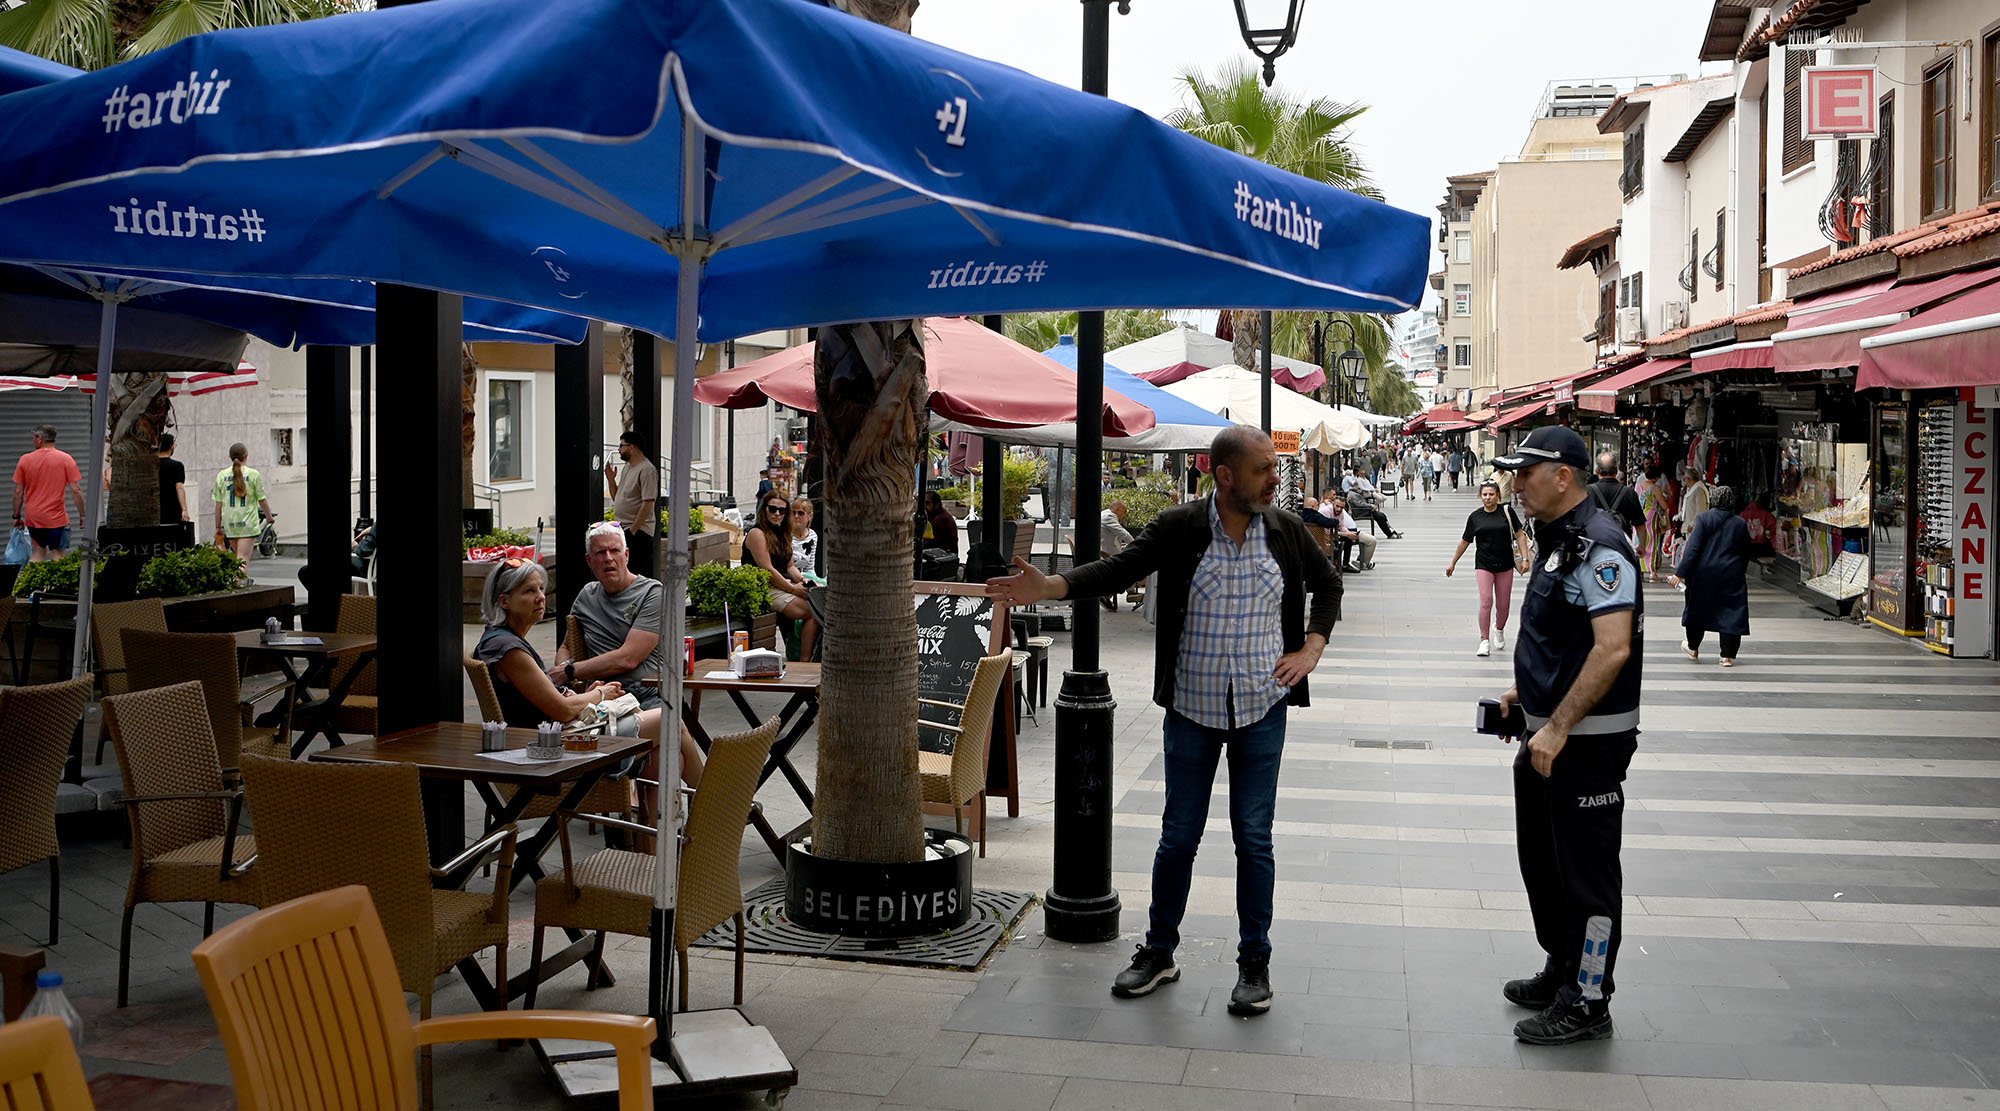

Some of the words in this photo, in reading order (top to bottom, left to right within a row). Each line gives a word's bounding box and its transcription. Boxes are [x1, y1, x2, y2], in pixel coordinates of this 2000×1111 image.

[102, 68, 231, 133] #artbir
[935, 96, 967, 147] +1
[1819, 79, 1862, 127] E
[1234, 180, 1323, 250] #artıbir
[1960, 400, 1987, 600] ECZANE
[916, 624, 948, 639] ca-Cola
[1577, 791, 1620, 808] ZABITA
